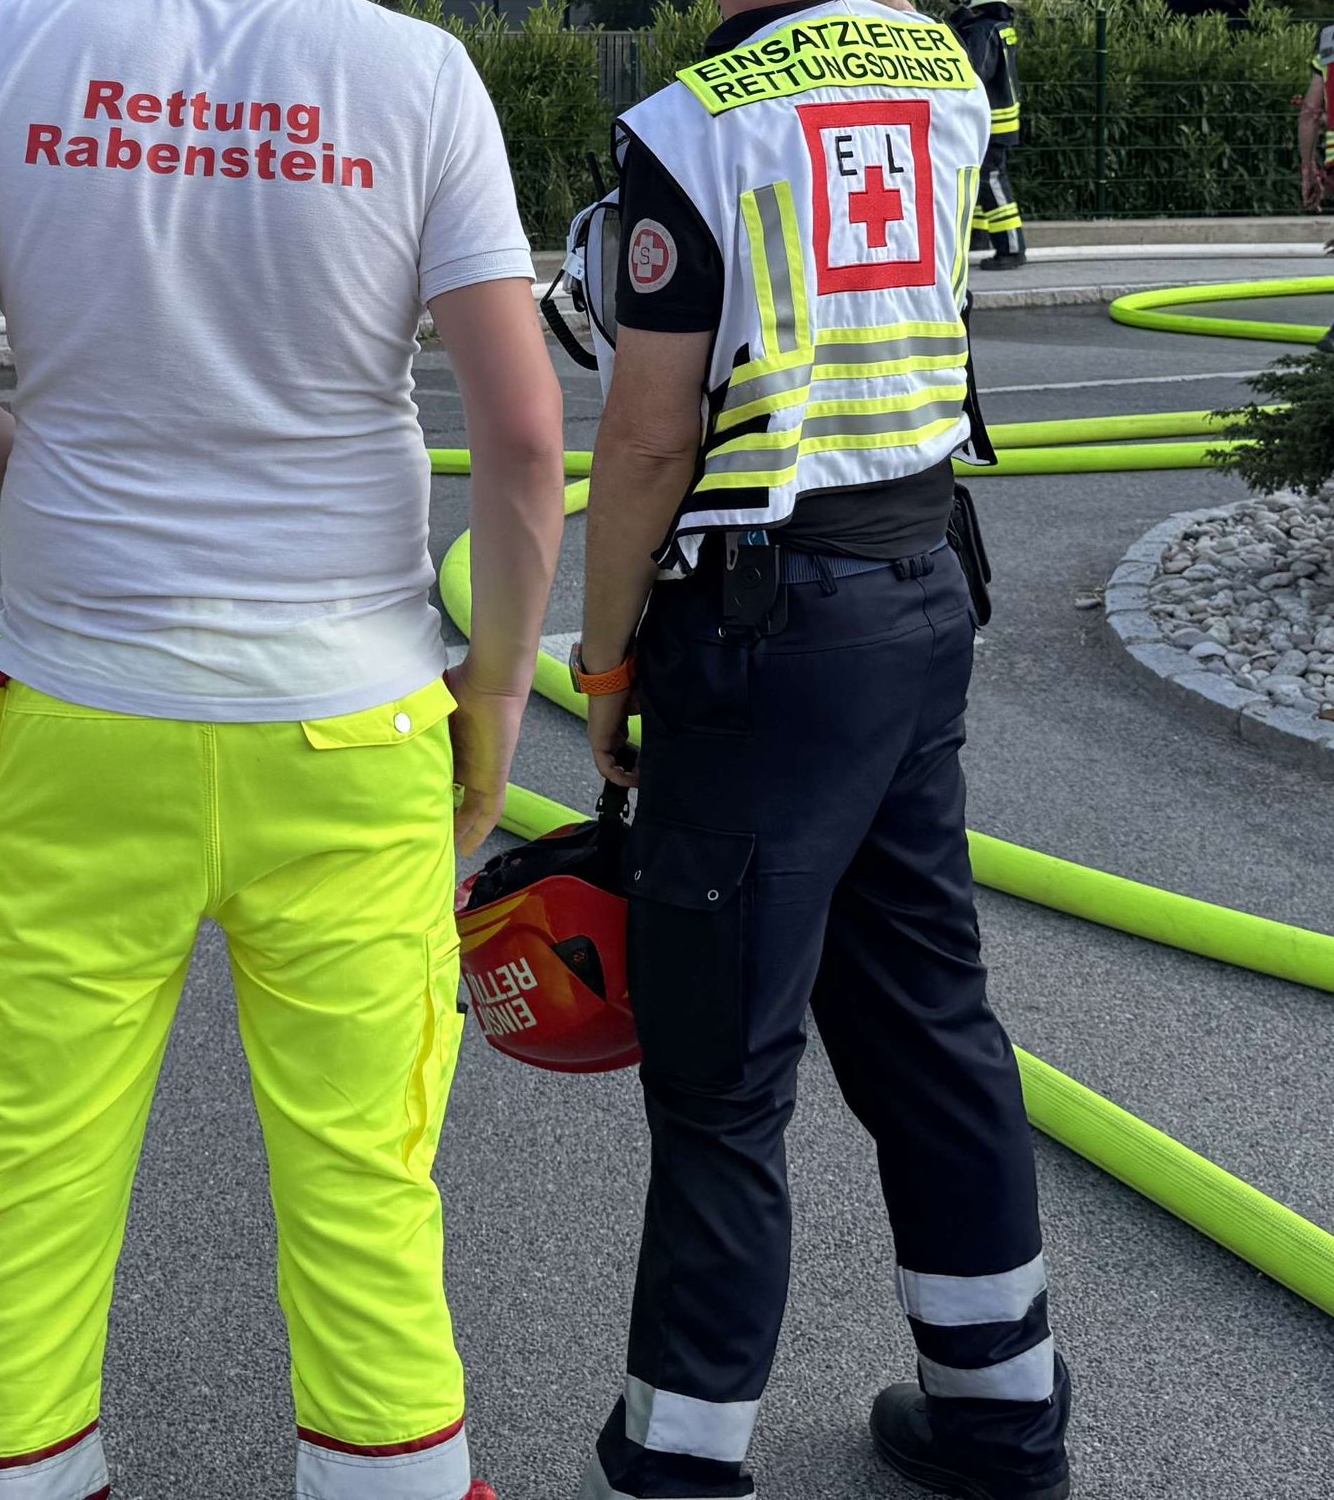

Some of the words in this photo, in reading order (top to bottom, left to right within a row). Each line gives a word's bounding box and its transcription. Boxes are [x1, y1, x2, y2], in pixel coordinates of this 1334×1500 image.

[693, 21, 953, 82] EINSATZLEITER
[710, 52, 965, 103] RETTUNGSDIENST
[83, 80, 321, 145] Rettung
[25, 123, 374, 189] Rabenstein
[835, 134, 857, 176] E
[885, 133, 904, 174] L
